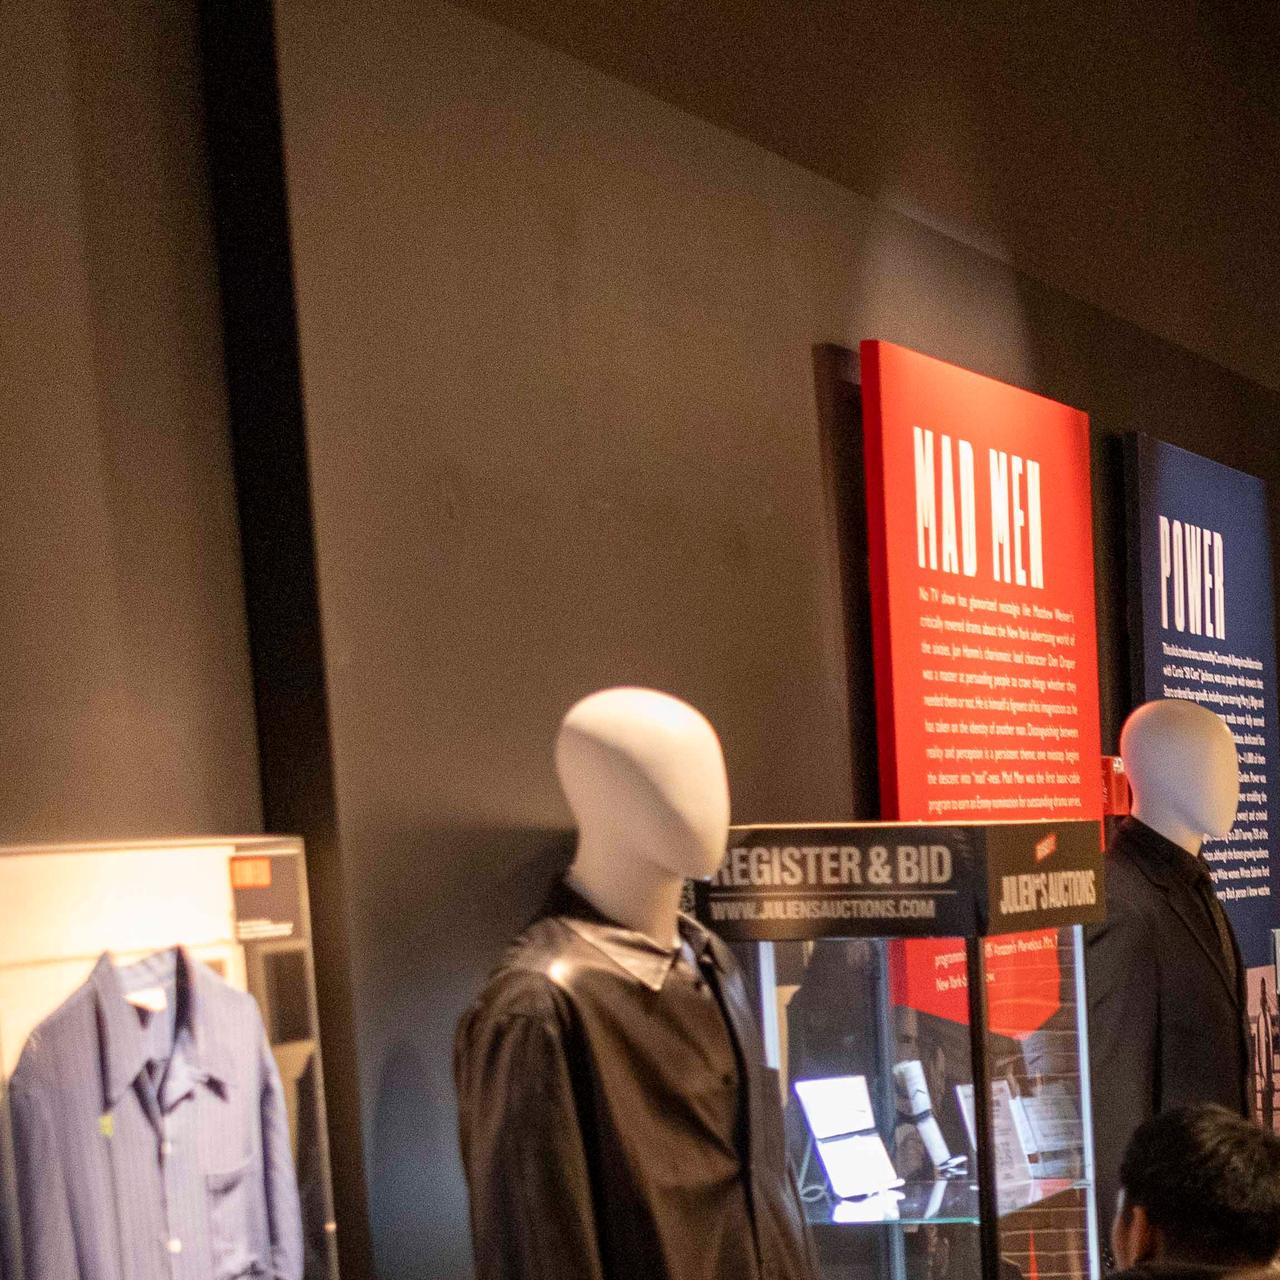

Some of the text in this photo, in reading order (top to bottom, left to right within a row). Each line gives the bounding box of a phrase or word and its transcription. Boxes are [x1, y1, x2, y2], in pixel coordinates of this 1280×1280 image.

[913, 426, 1044, 589] MAD MEN
[1159, 516, 1225, 640] POWER
[868, 846, 892, 884] &
[897, 845, 952, 884] BID
